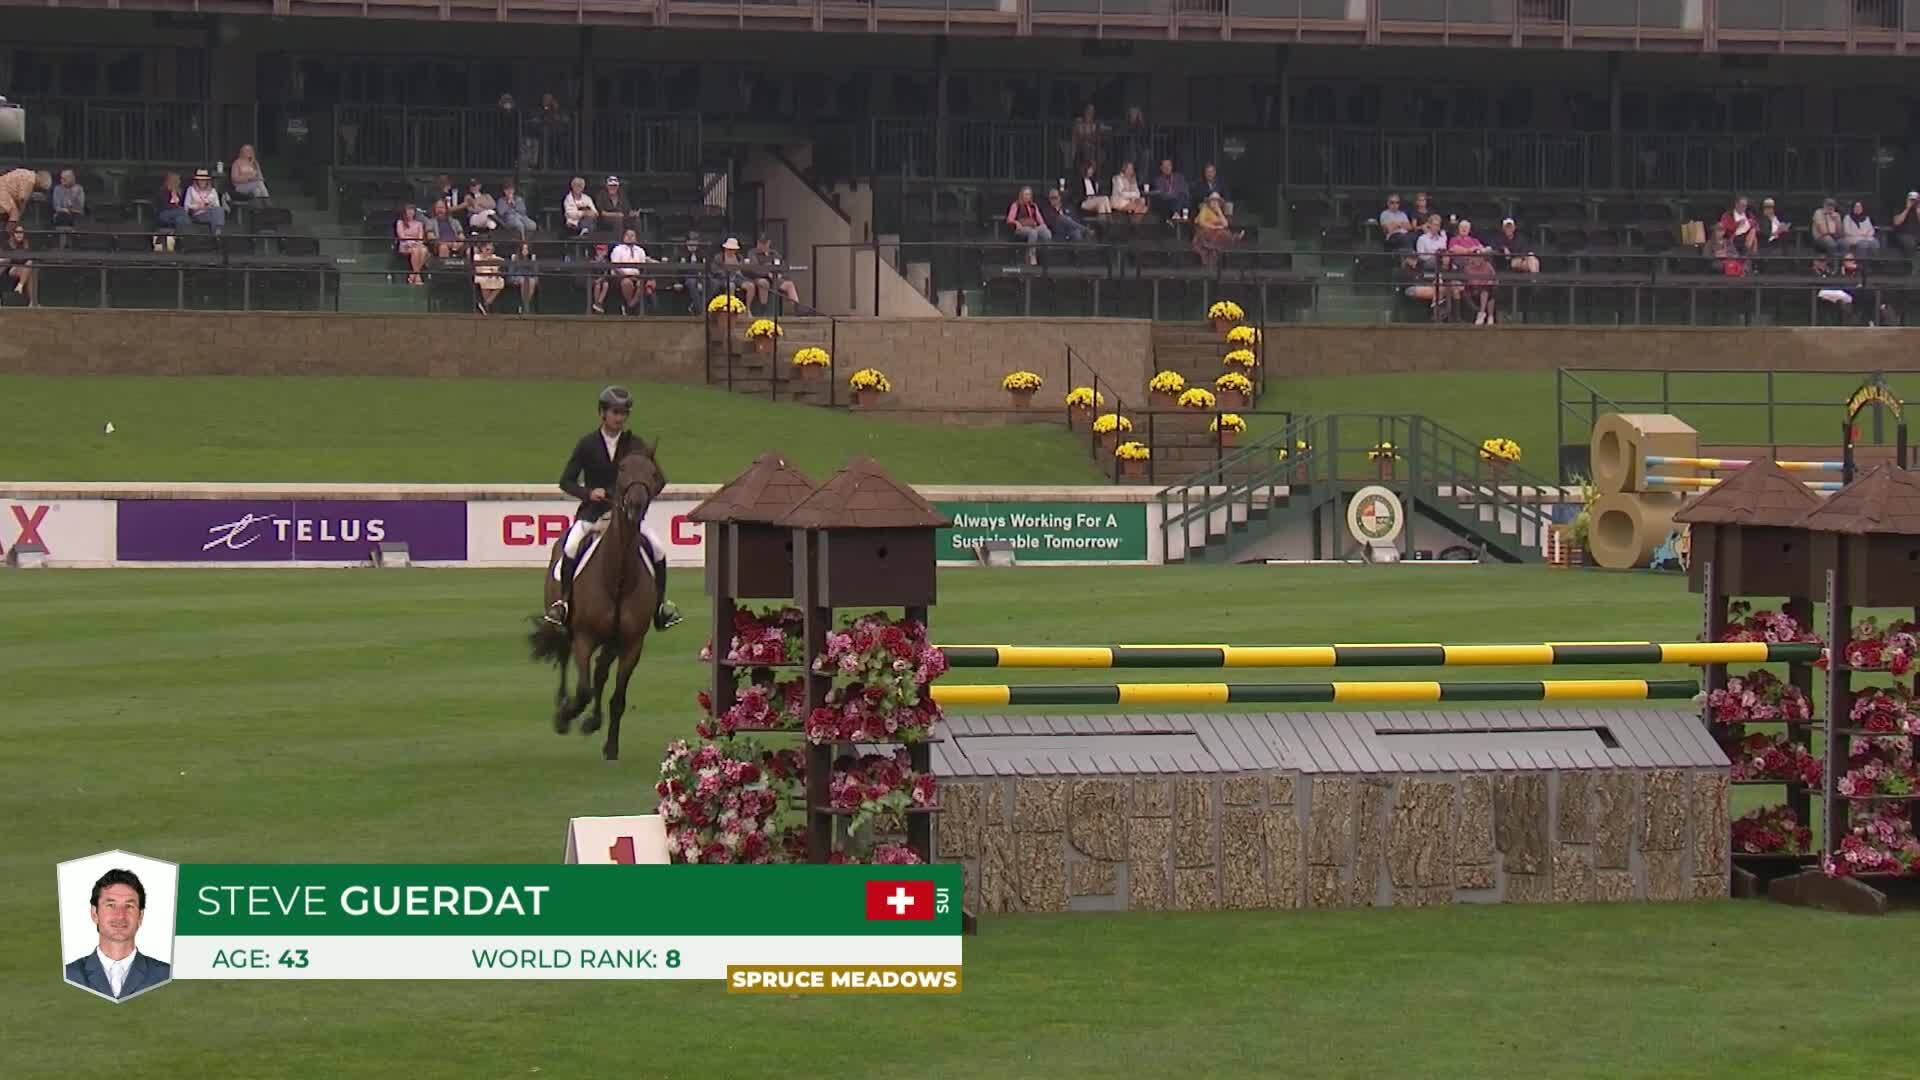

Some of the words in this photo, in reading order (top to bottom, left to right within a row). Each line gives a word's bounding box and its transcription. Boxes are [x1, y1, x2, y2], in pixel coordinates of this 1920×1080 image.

[273, 519, 385, 542] TELUS
[953, 513, 1006, 531] Always
[1010, 513, 1072, 531] Working
[1077, 513, 1101, 528] For
[1106, 513, 1117, 528] A
[1044, 534, 1118, 548] Tomorrow
